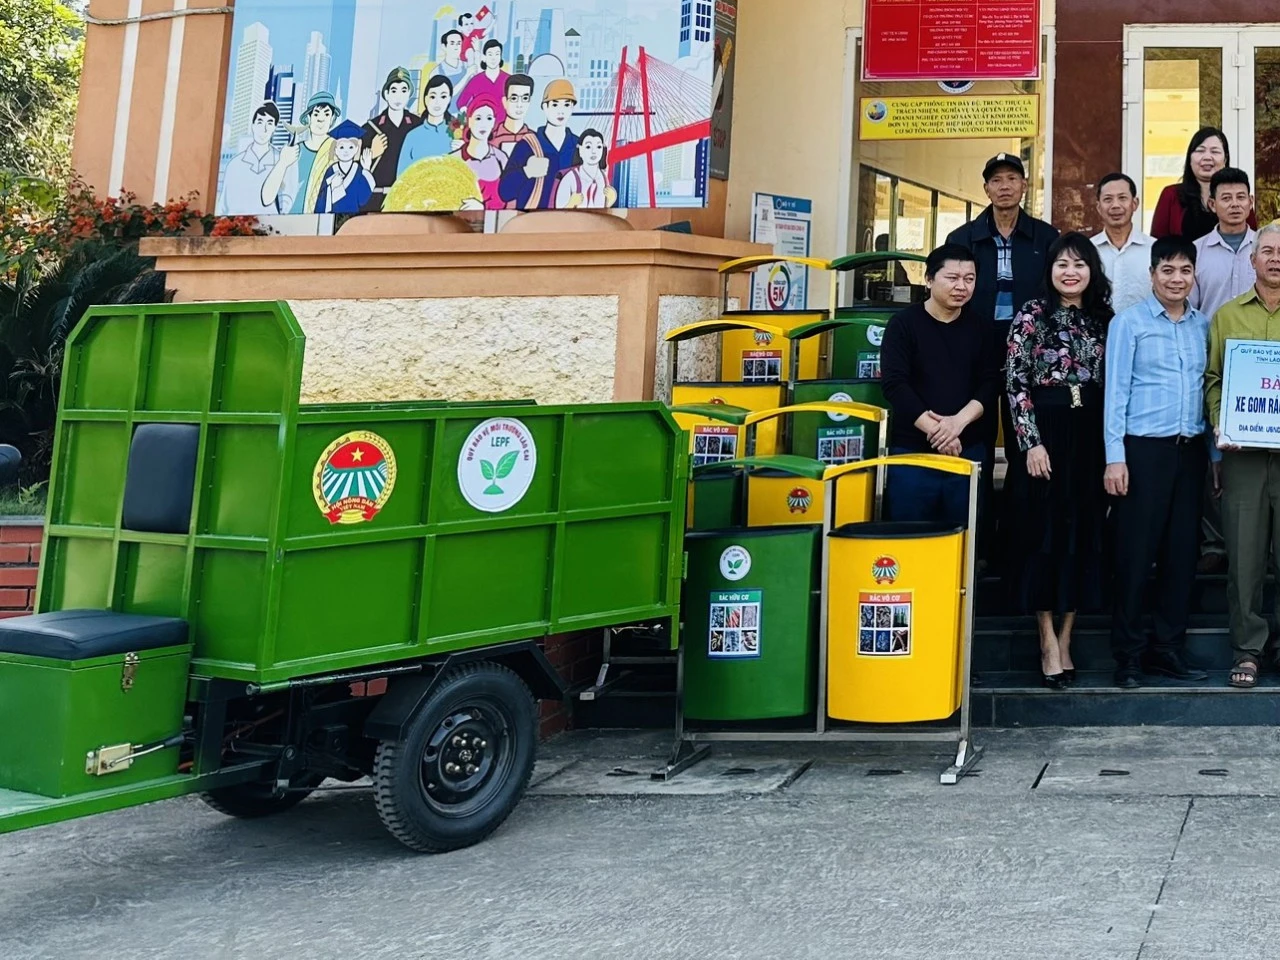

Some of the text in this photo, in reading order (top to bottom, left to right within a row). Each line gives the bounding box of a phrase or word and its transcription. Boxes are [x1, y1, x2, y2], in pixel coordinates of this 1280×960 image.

[773, 286, 785, 301] 5K
[1235, 396, 1245, 413] XE
[1248, 397, 1266, 413] GOM
[491, 436, 510, 448] LEPF
